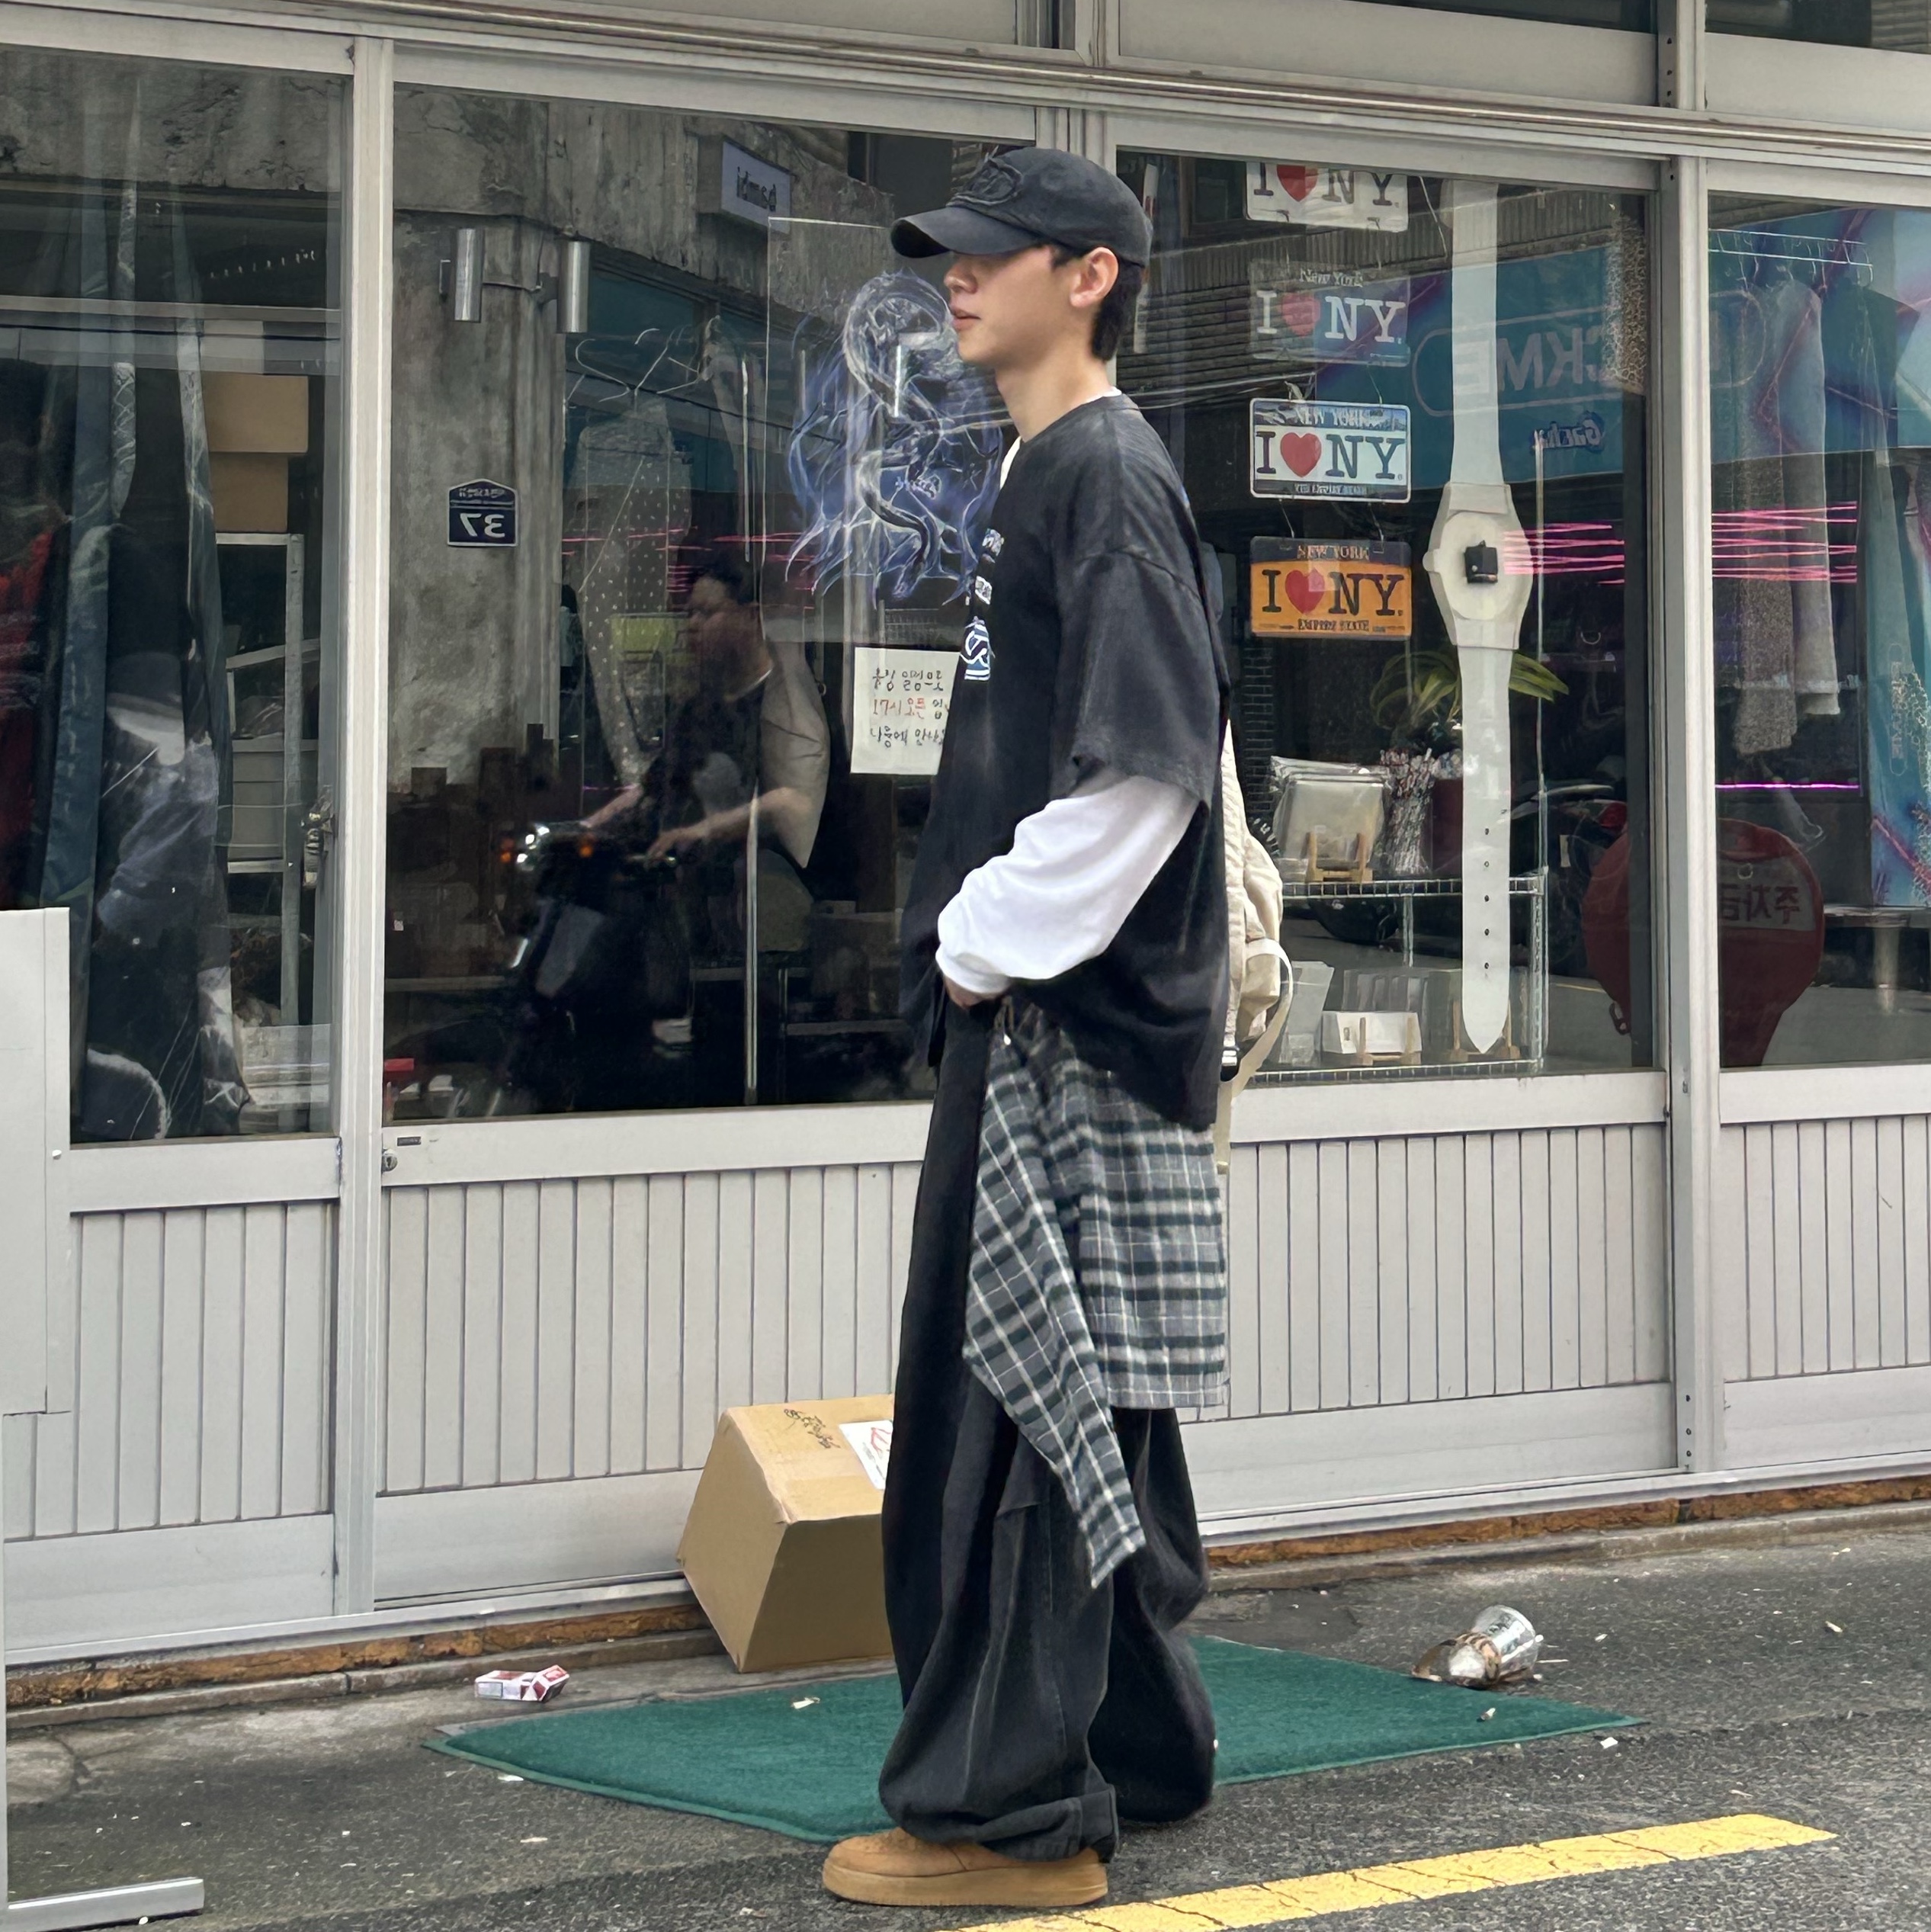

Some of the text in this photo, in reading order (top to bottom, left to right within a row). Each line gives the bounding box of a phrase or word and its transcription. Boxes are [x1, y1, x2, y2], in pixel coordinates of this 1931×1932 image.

[1253, 162, 1393, 206] I NY
[1256, 290, 1407, 343] I NY
[1256, 431, 1406, 480] I NY
[1262, 569, 1405, 616] I NY
